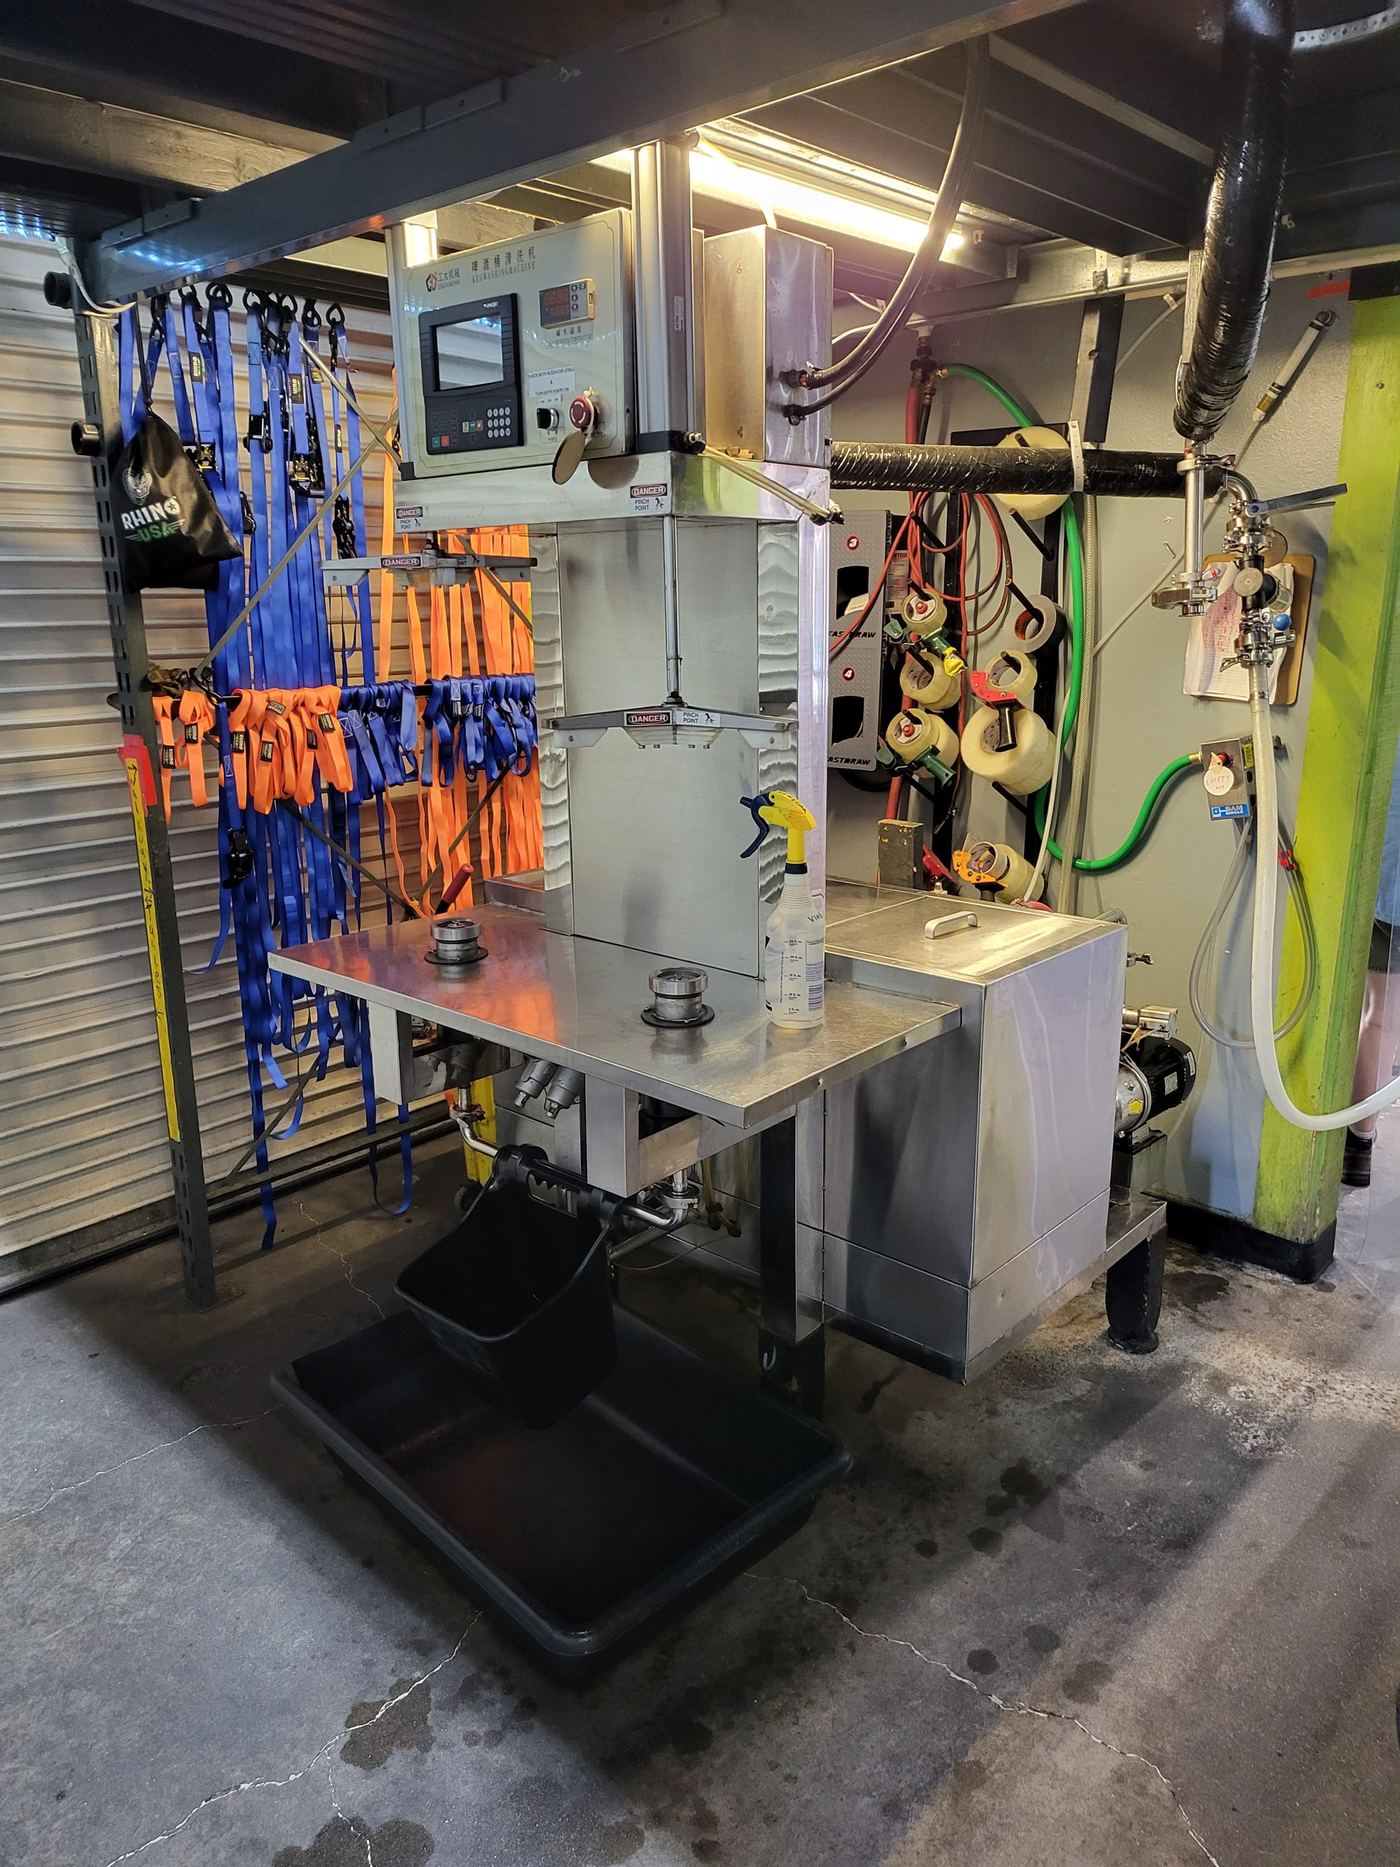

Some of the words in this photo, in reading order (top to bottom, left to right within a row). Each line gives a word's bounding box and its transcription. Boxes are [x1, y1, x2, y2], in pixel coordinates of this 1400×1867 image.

[633, 486, 665, 495] DANGER
[121, 497, 181, 530] RHINO
[138, 523, 175, 542] USA
[849, 538, 858, 548] 3
[384, 558, 417, 566] DANGER
[844, 669, 853, 678] 4
[631, 715, 666, 723] DANGER
[827, 756, 871, 766] ASTDRAW
